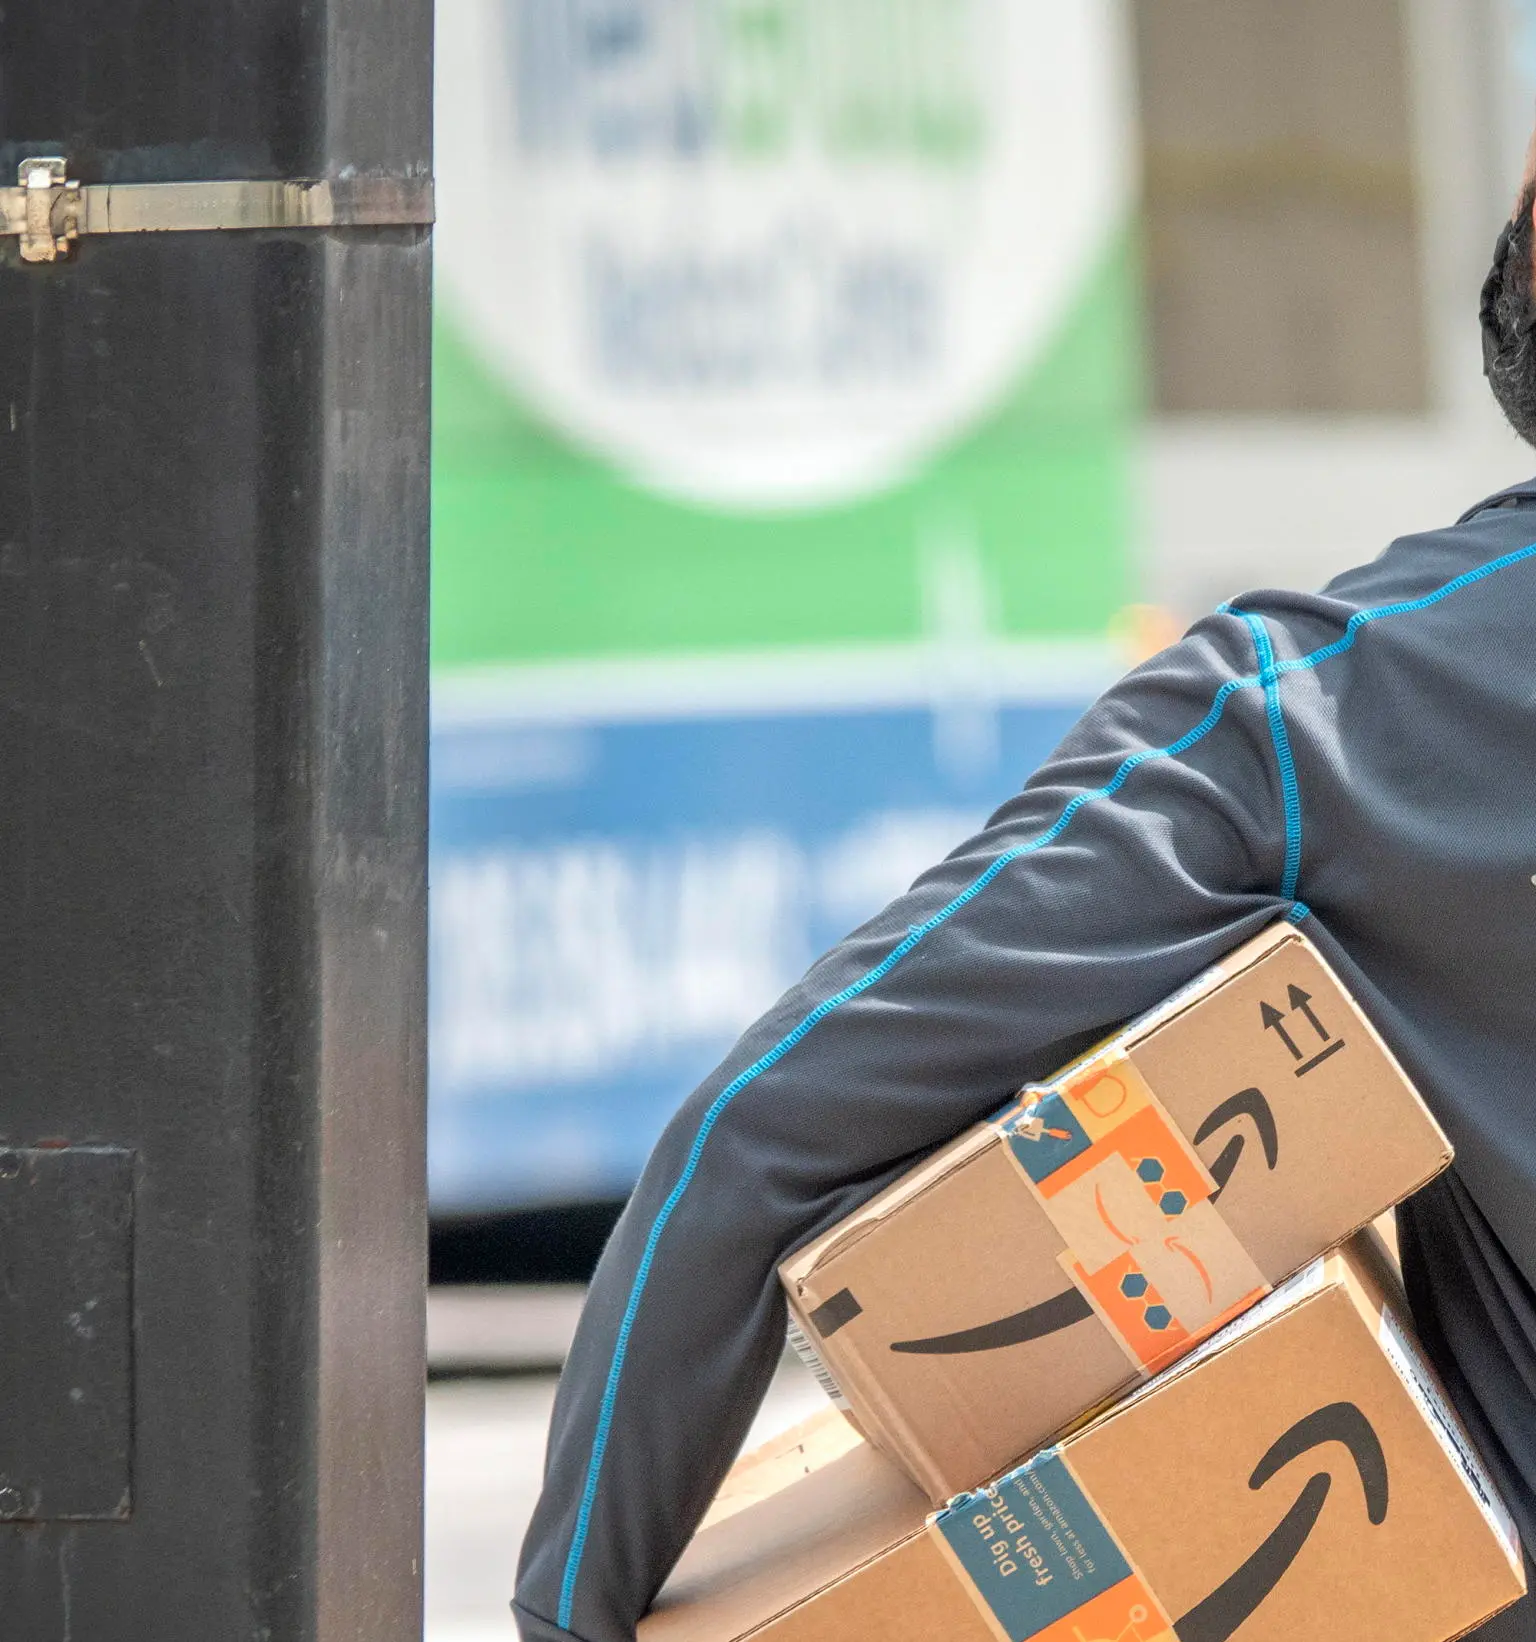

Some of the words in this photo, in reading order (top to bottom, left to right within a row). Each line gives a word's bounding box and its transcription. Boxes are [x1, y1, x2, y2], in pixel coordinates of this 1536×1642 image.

[1013, 1478, 1030, 1497] and
[985, 1484, 1025, 1534] price
[1029, 1496, 1054, 1531] garden,
[972, 1514, 996, 1540] up
[1065, 1529, 1076, 1540] at
[1051, 1531, 1068, 1557] lawn,
[1074, 1540, 1087, 1559] less
[991, 1540, 1018, 1577] Dig
[1016, 1535, 1054, 1586] fresh
[1065, 1556, 1084, 1580] Shop
[1083, 1559, 1096, 1574] for
